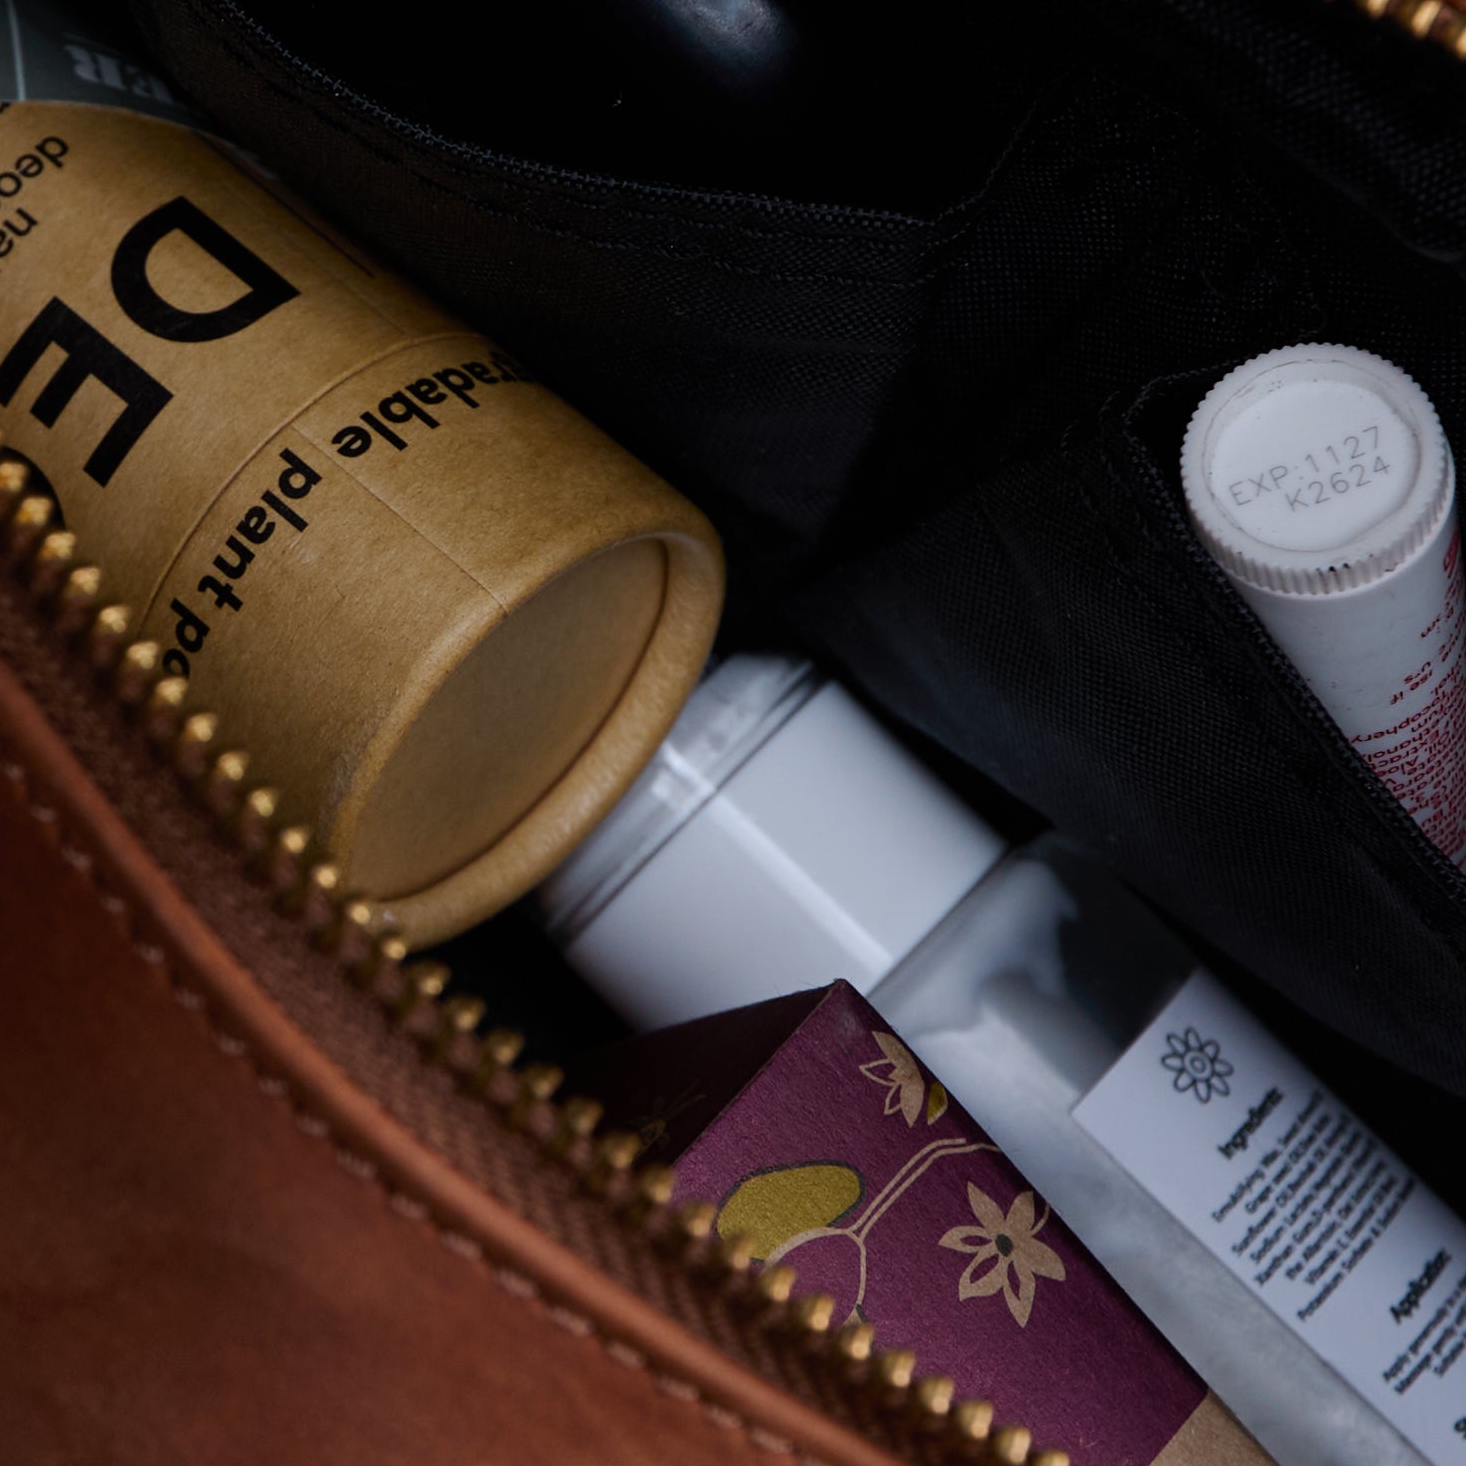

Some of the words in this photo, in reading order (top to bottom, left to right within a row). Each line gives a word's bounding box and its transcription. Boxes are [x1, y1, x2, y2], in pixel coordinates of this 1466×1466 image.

[331, 349, 529, 456] gradable
[1283, 456, 1389, 511] K2624
[197, 448, 324, 609] plant
[164, 597, 212, 680] po
[1351, 692, 1446, 741] Tocophery
[1391, 691, 1402, 704] if
